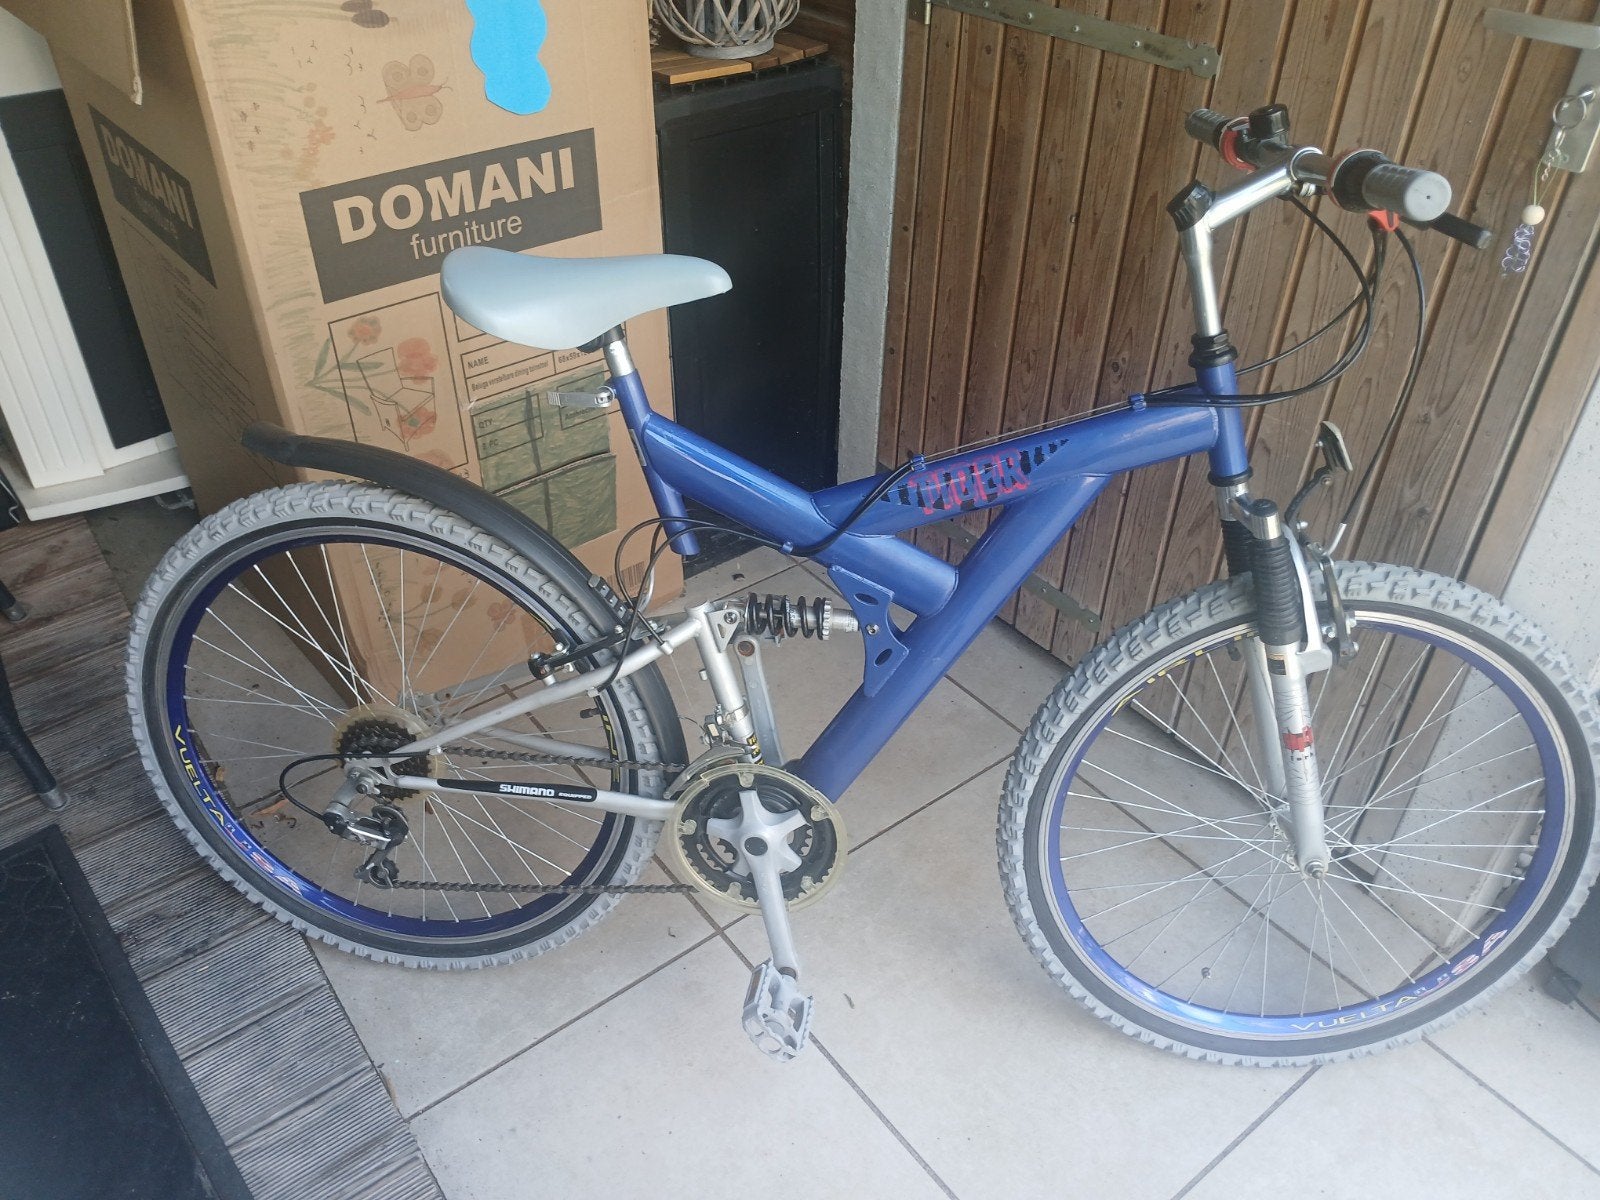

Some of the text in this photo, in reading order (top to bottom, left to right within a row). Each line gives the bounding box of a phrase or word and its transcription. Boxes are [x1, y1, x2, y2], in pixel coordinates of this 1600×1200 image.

[99, 124, 194, 229] DOMANI
[333, 147, 575, 244] DOMANI
[410, 215, 523, 260] furniture
[468, 356, 489, 369] NAME
[478, 418, 494, 429] QTY
[174, 724, 225, 826] VUELTA
[499, 783, 593, 800] SHIMANO EQUIPPED
[1290, 994, 1419, 1032] VUELTA
